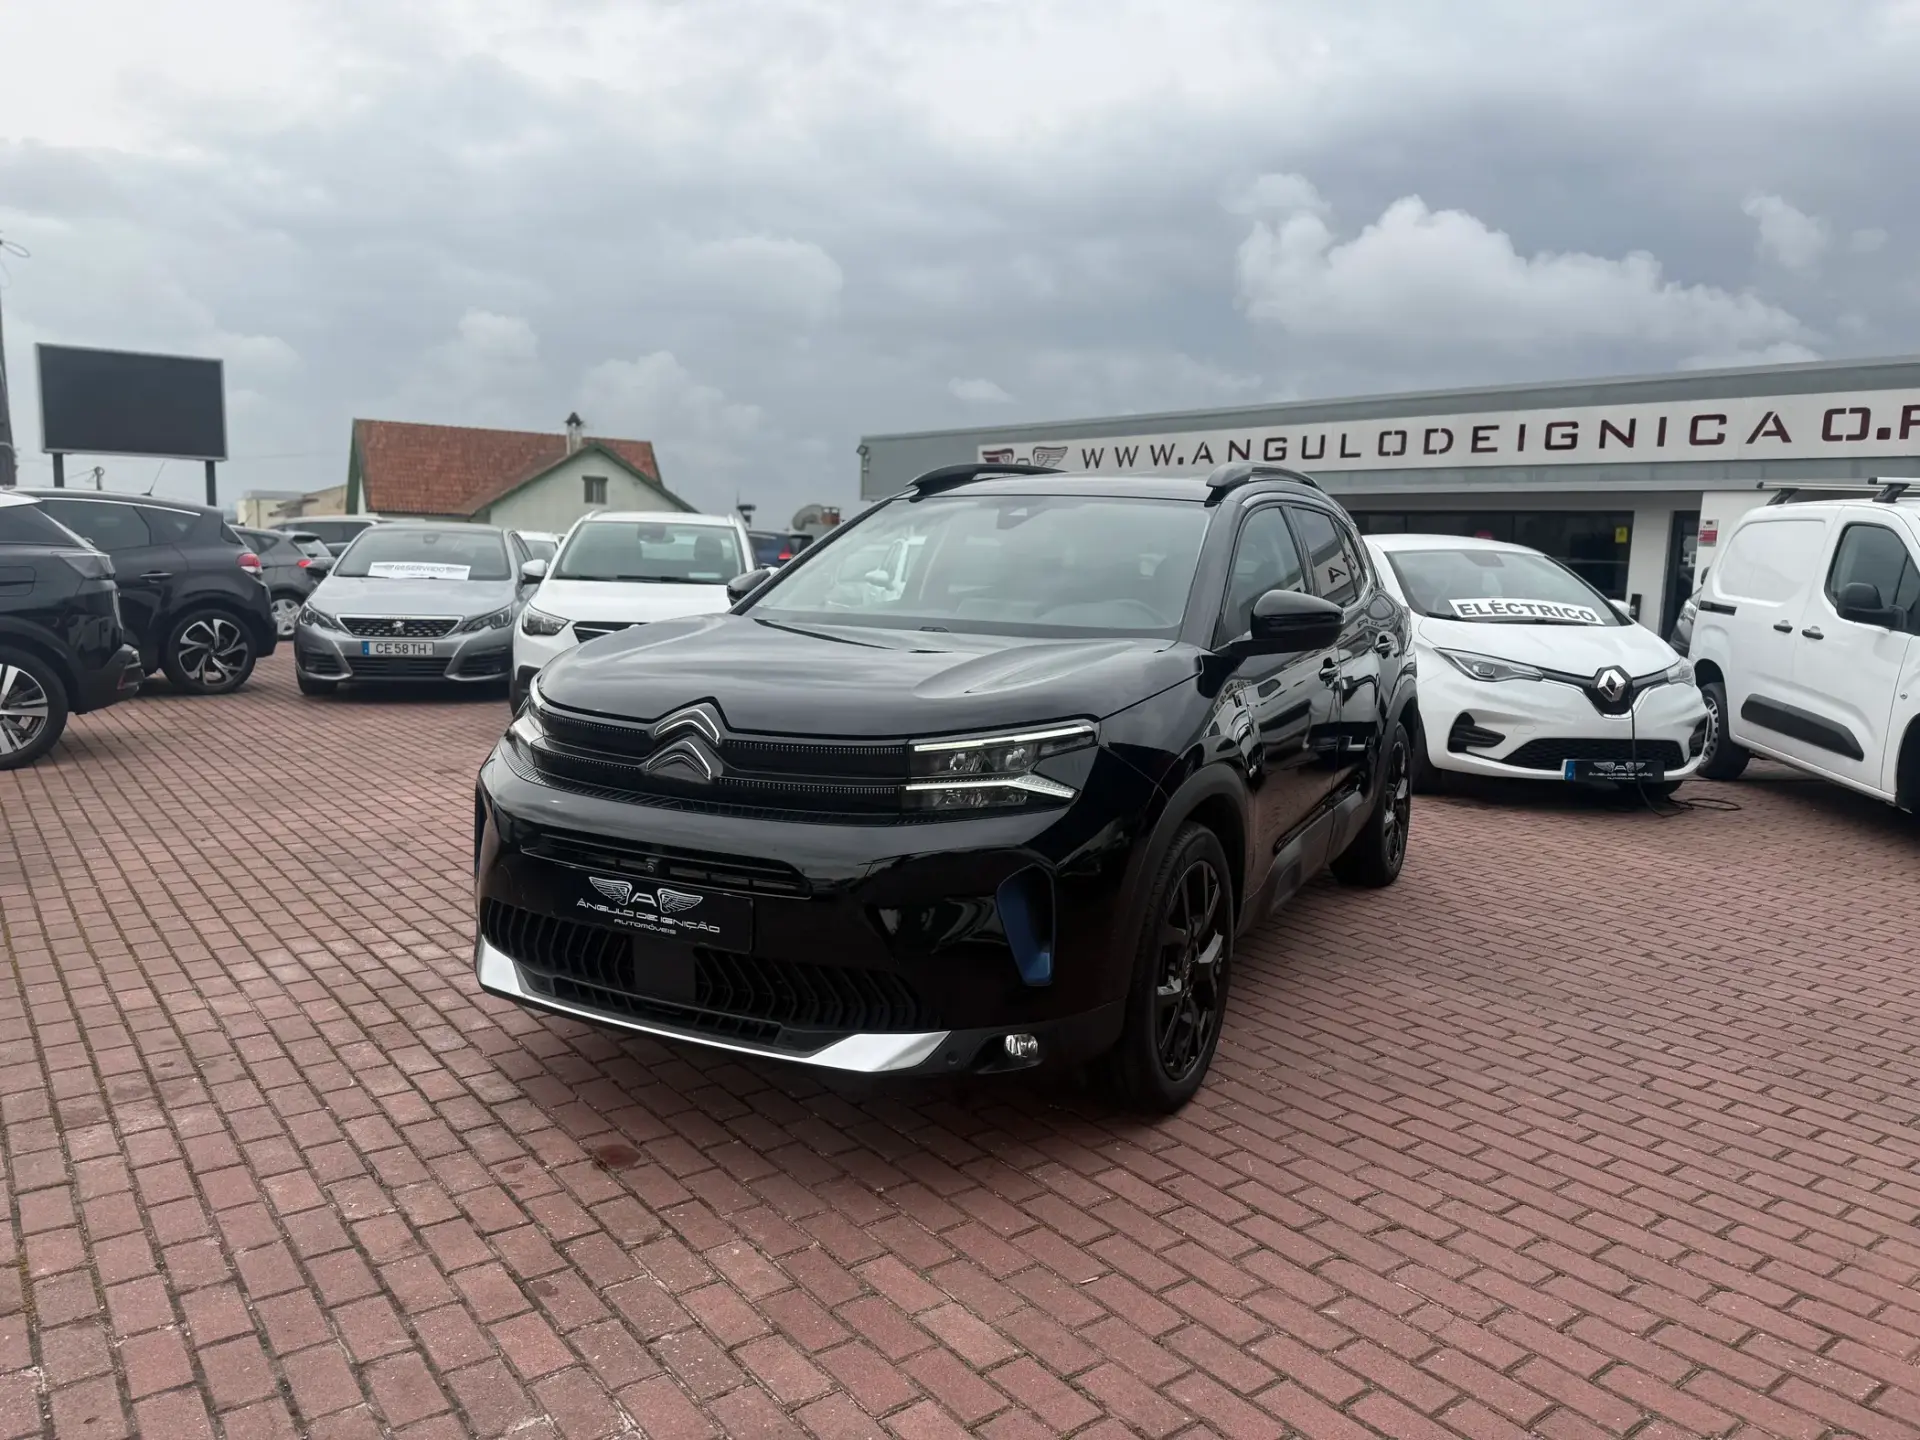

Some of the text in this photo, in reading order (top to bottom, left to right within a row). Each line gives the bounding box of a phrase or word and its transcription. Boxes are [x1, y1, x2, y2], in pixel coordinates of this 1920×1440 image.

[1457, 600, 1597, 622] ELÉCTRICO
[376, 643, 427, 655] CE 58 TH
[636, 911, 659, 922] DE
[660, 916, 720, 933] IGNIÇÃO
